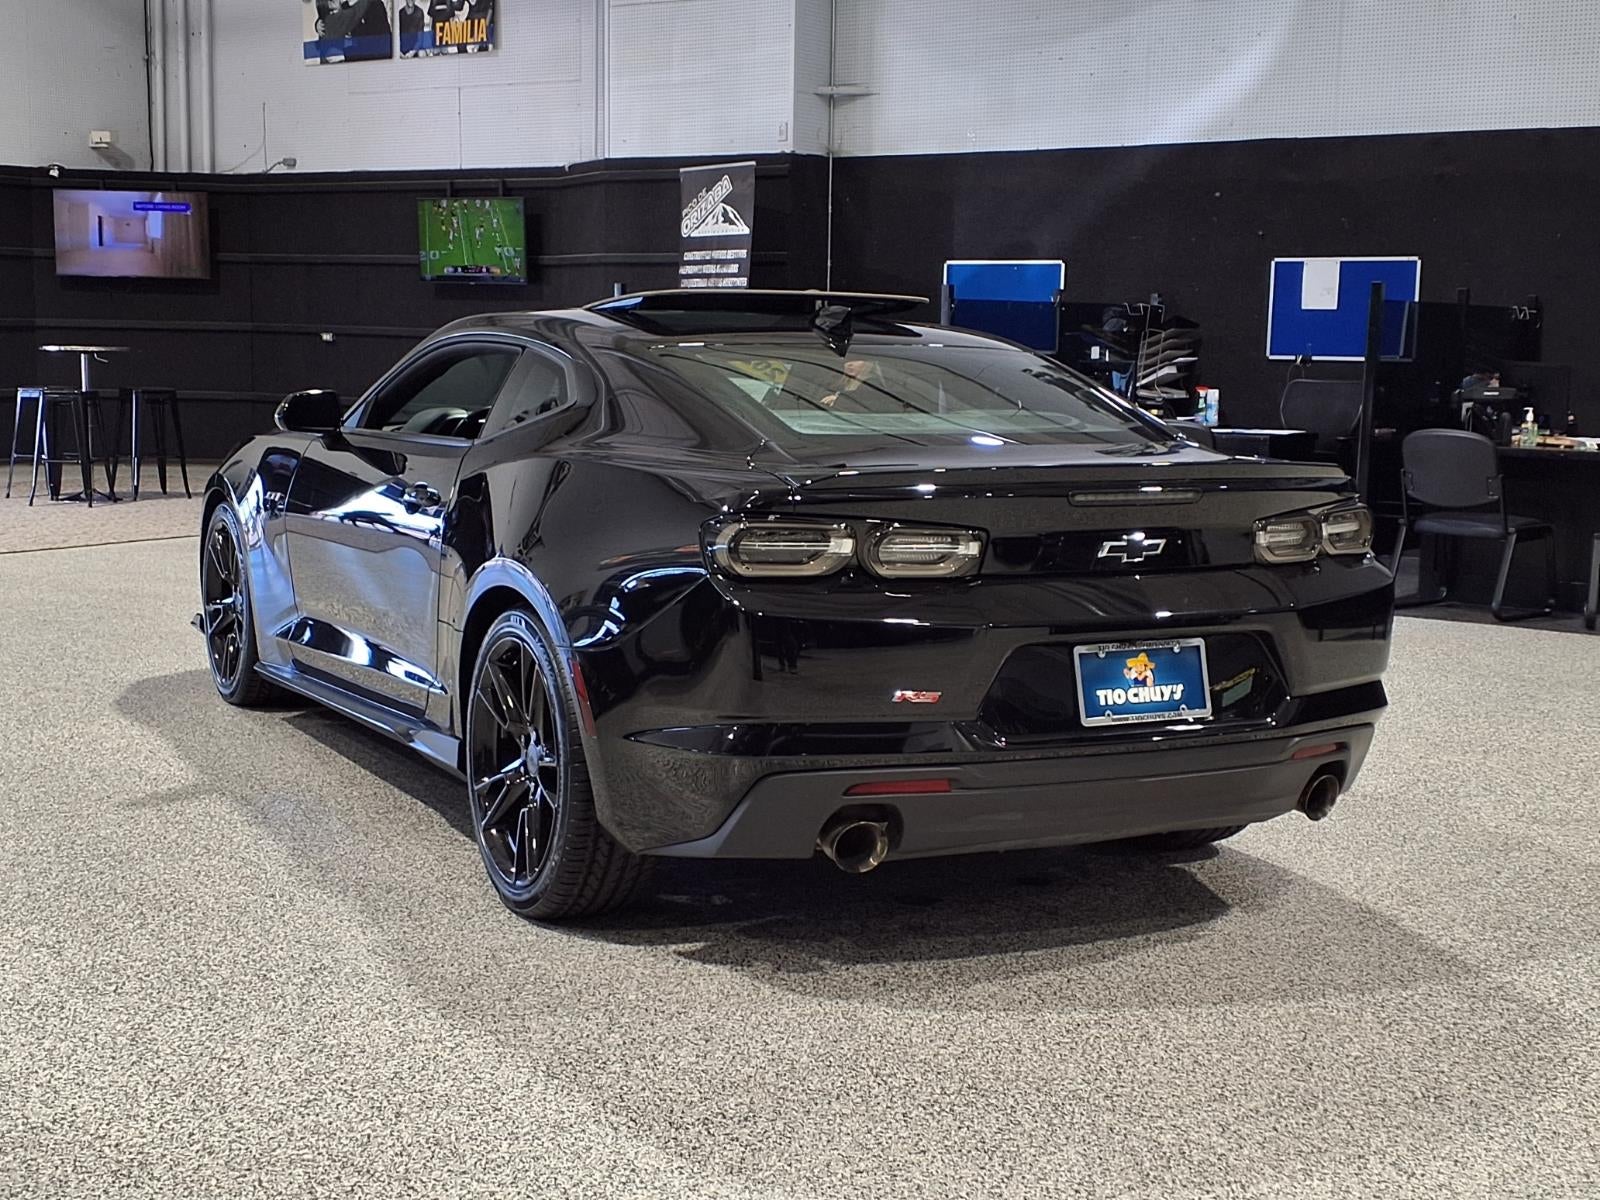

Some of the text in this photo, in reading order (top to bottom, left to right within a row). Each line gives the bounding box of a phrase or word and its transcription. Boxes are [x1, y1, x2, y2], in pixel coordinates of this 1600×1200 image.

[435, 18, 487, 46] FAMILIA
[681, 175, 733, 237] ORIZABA
[1096, 683, 1185, 706] TIO CHUY'S
